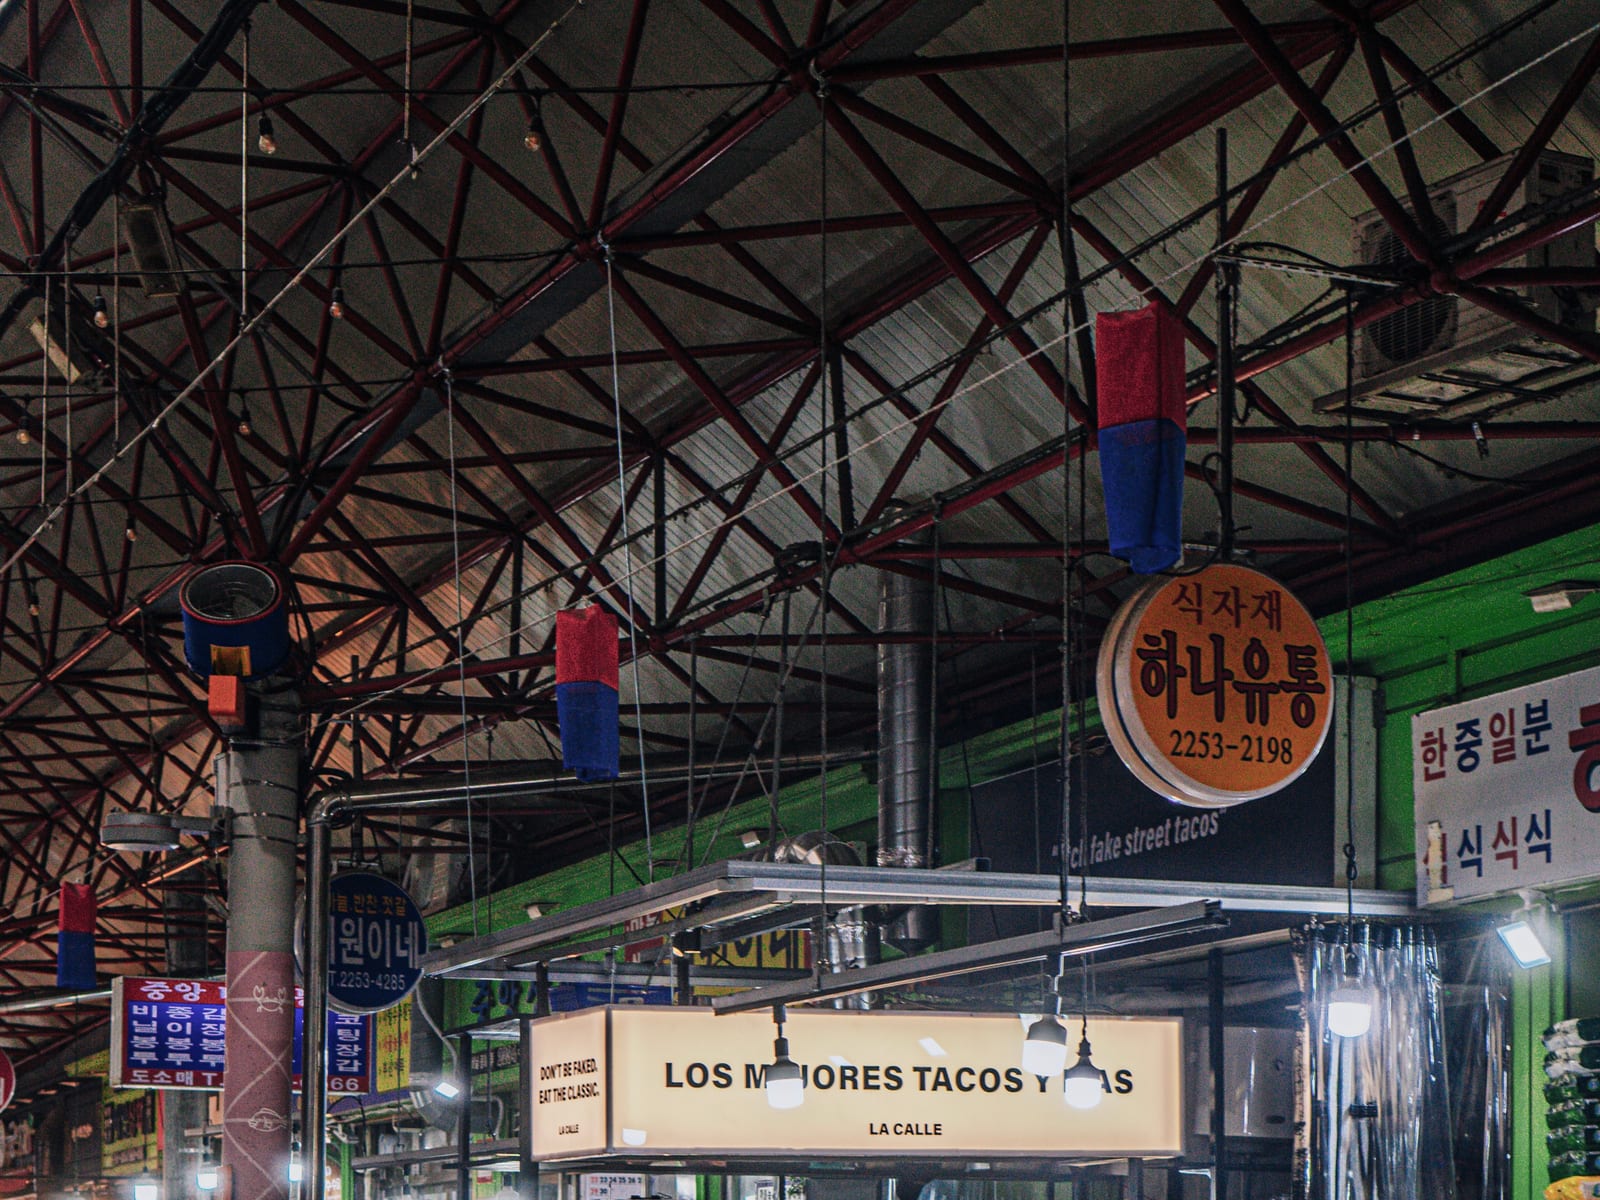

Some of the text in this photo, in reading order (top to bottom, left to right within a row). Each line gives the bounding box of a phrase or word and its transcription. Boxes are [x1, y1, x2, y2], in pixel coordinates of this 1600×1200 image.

[1171, 582, 1281, 632] 식자재
[1136, 629, 1326, 728] 하나유통
[1170, 730, 1293, 765] 2253-2198
[1089, 831, 1122, 865] fake
[1124, 818, 1172, 856] street
[329, 915, 419, 969] 원이네
[140, 980, 207, 1002] 중앙
[540, 1063, 562, 1081] DON'T
[563, 1062, 572, 1078] BE
[665, 1062, 733, 1089] LOS
[745, 1063, 904, 1091] MJORES
[912, 1066, 1024, 1093] TACOS
[539, 1088, 551, 1104] EAT
[553, 1086, 566, 1103] THE
[870, 1123, 942, 1136] LA CALLE
